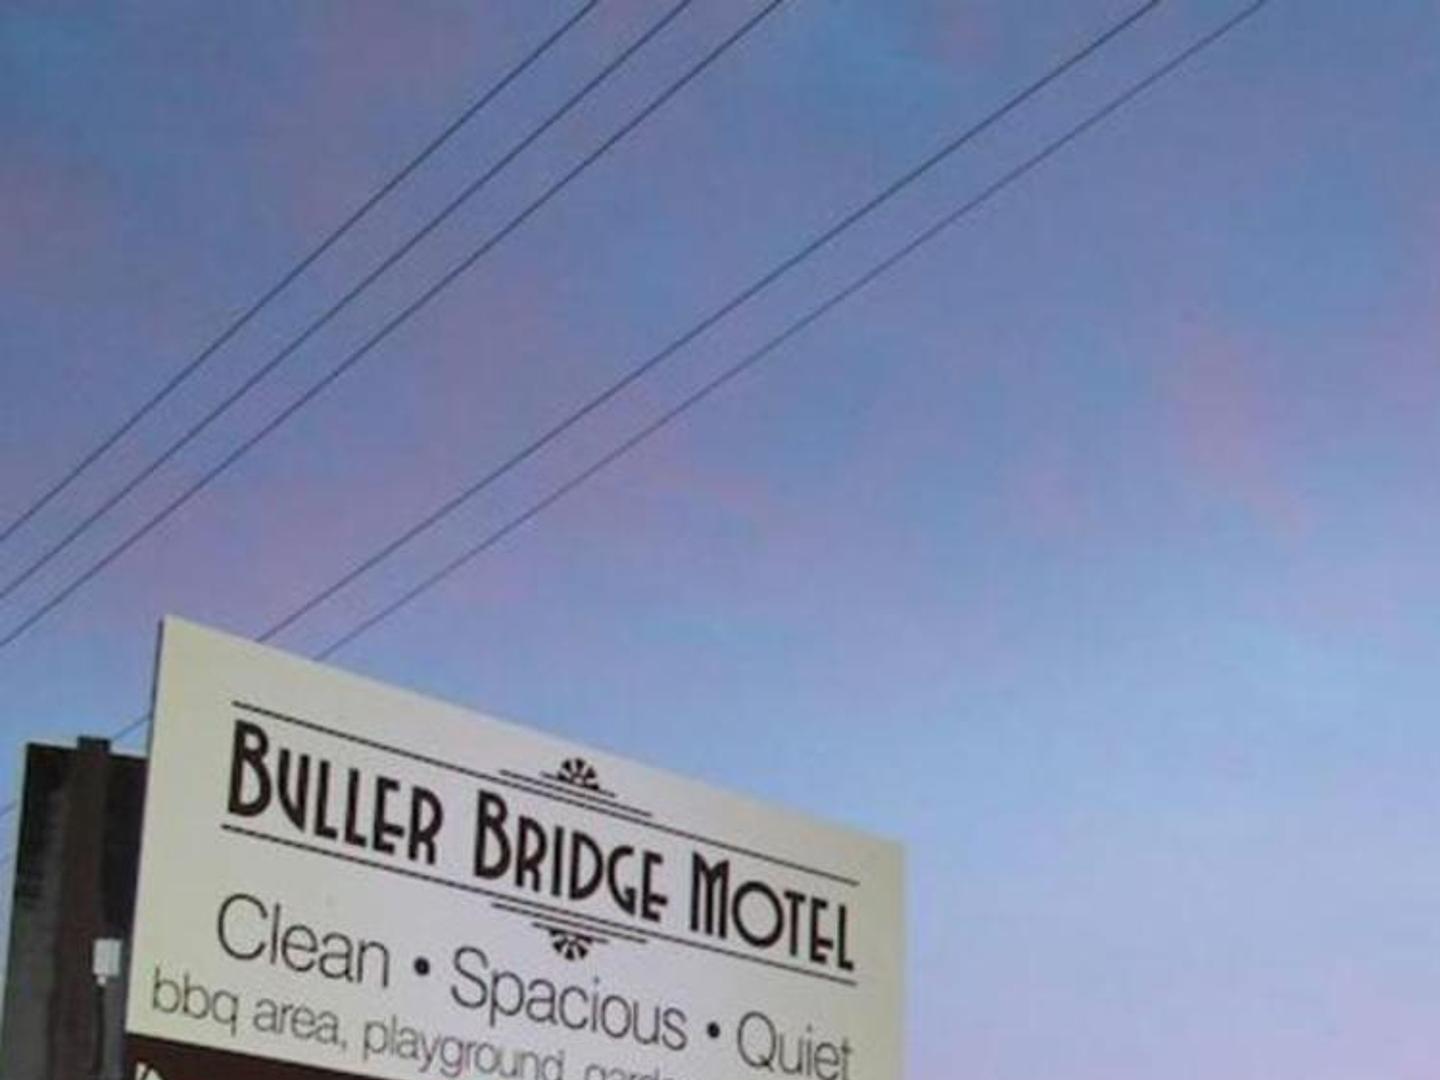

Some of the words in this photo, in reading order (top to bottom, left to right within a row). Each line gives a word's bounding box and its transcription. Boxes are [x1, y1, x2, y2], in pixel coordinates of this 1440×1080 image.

[228, 719, 443, 865] BULLER
[473, 789, 668, 922] BRIDGE
[690, 851, 854, 971] MOTEL
[151, 964, 239, 1036] bbq
[252, 998, 348, 1048] area,
[217, 892, 390, 988] Clean
[450, 945, 688, 1052] Spacious
